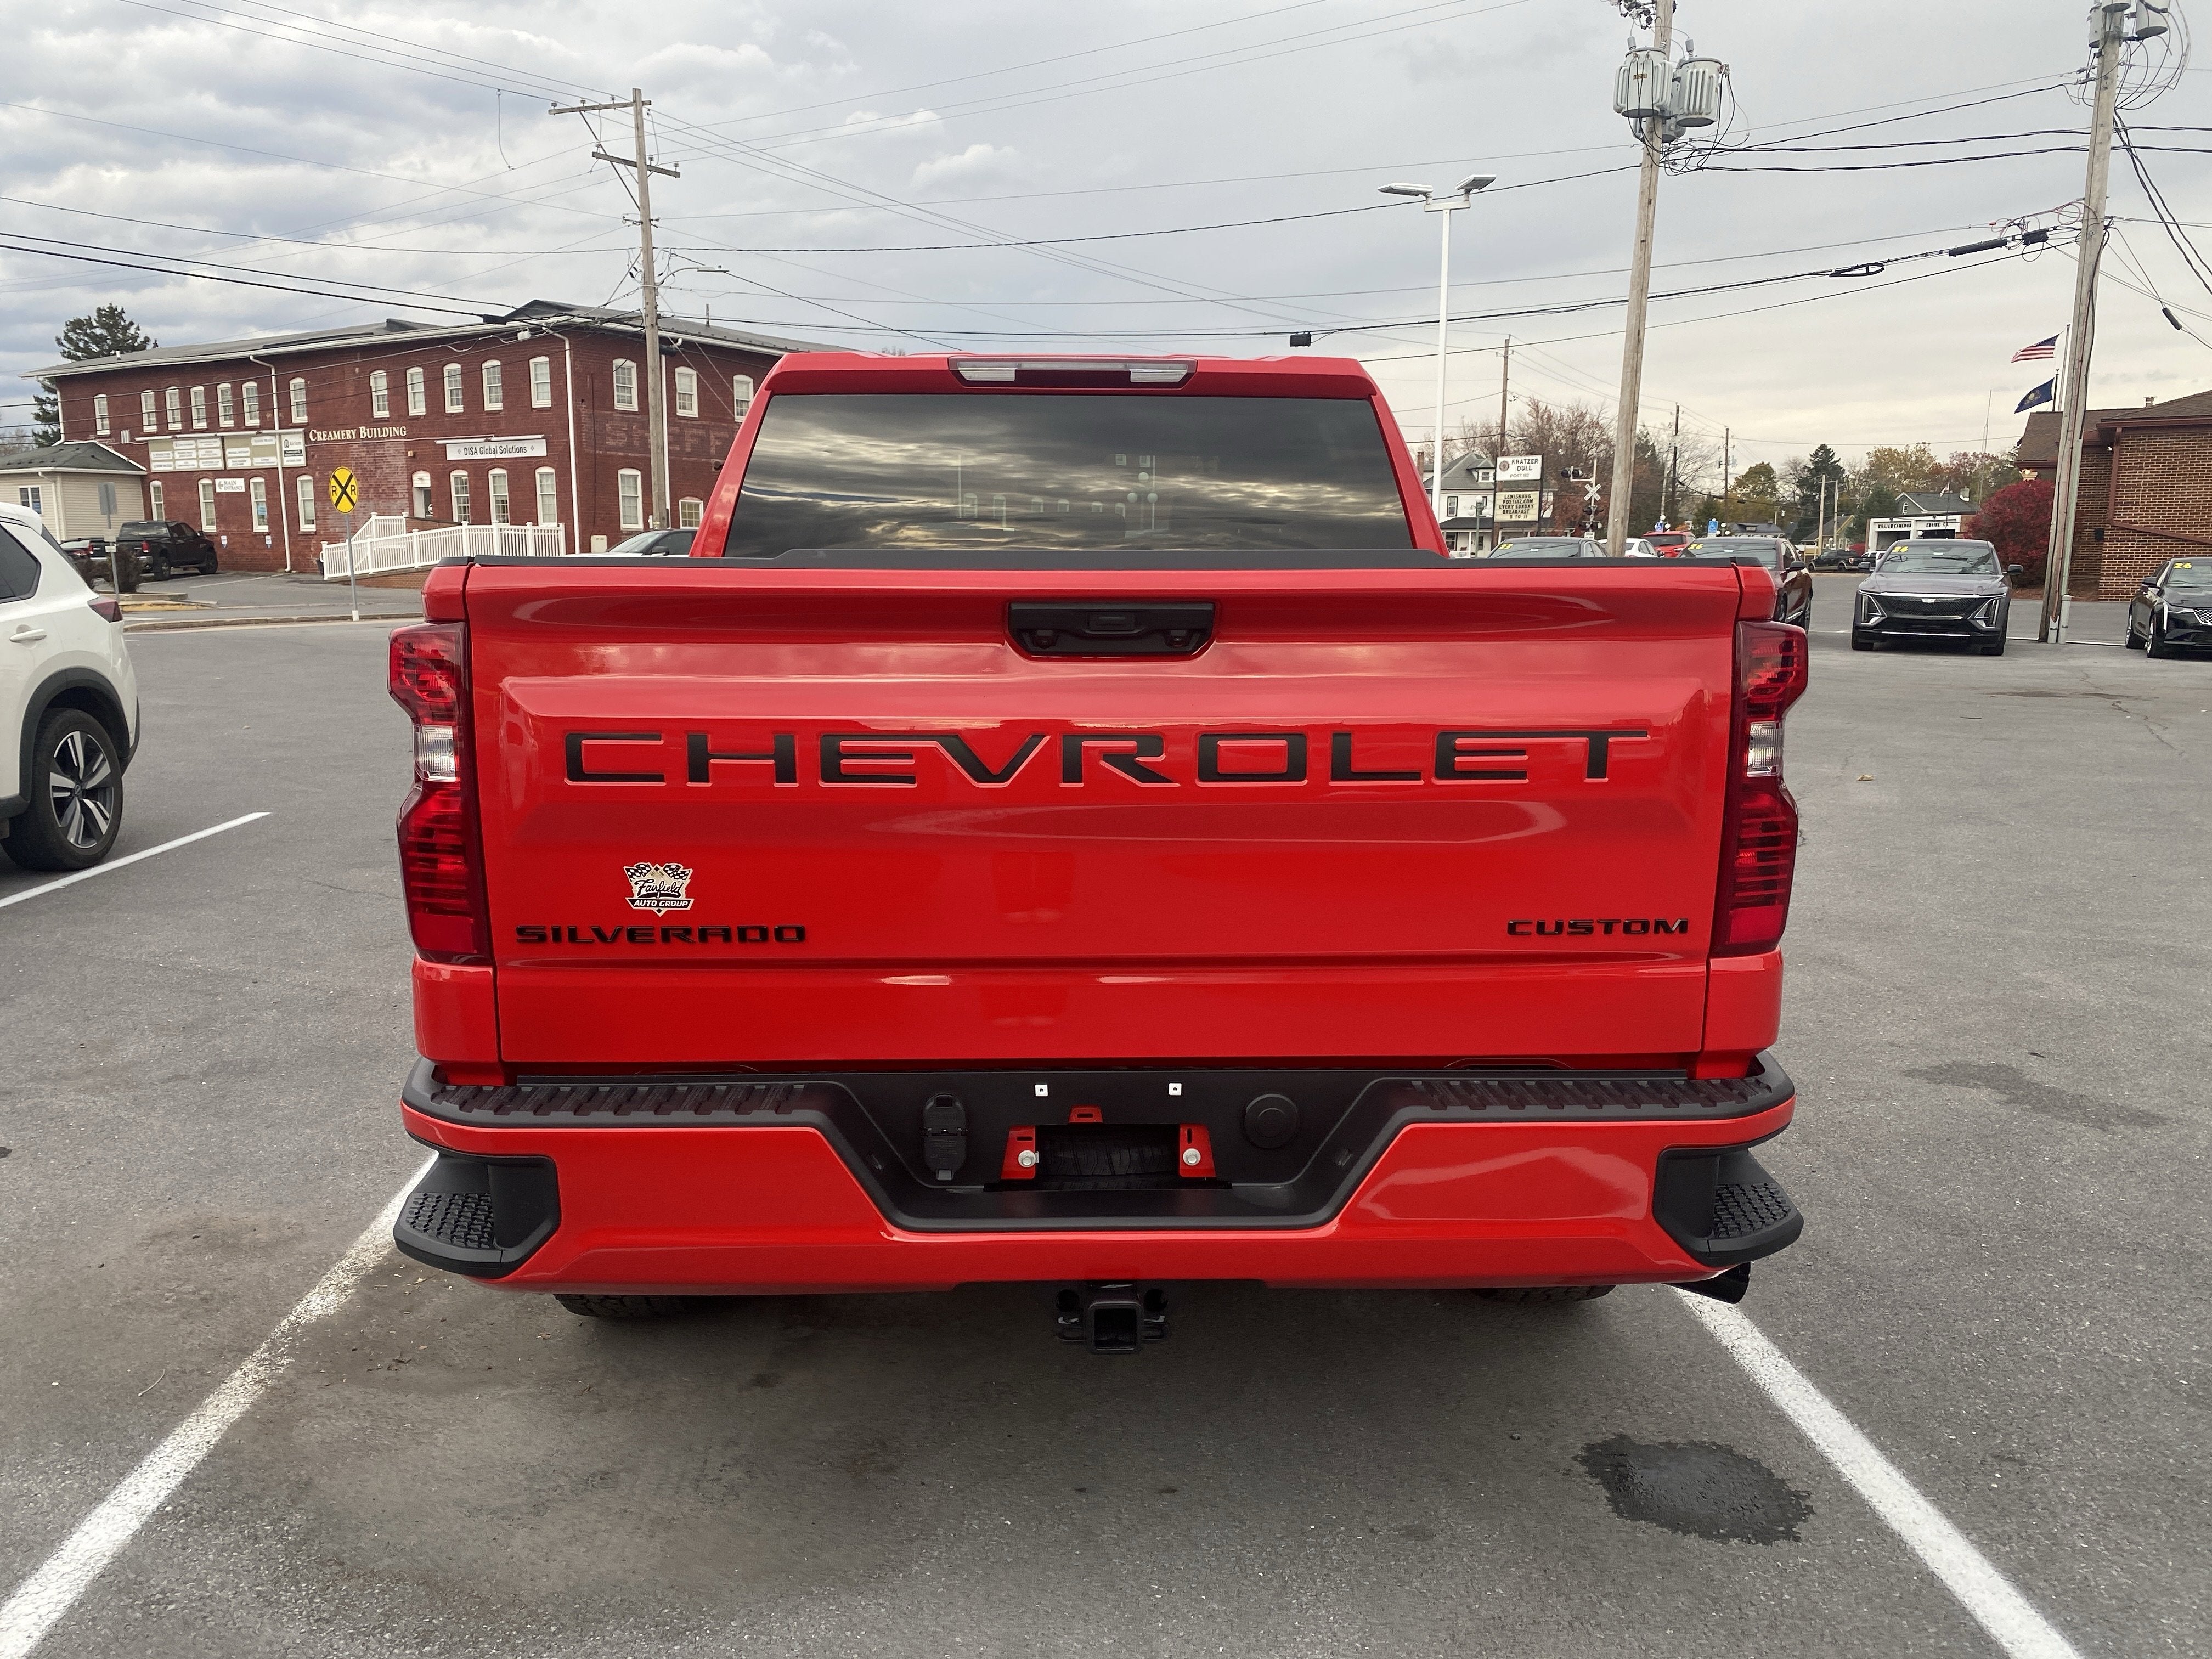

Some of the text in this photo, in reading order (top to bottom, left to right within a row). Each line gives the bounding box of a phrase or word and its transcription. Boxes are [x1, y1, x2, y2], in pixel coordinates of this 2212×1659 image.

[309, 426, 407, 442] CREAMERY BUILDING
[464, 444, 527, 456] DISA Global Solutions
[331, 484, 356, 496] R R
[564, 730, 1650, 788] CHEVROLET
[634, 878, 684, 899] Fairfield
[515, 925, 806, 944] SILVERADO
[1507, 918, 1689, 936] CUSTOM
